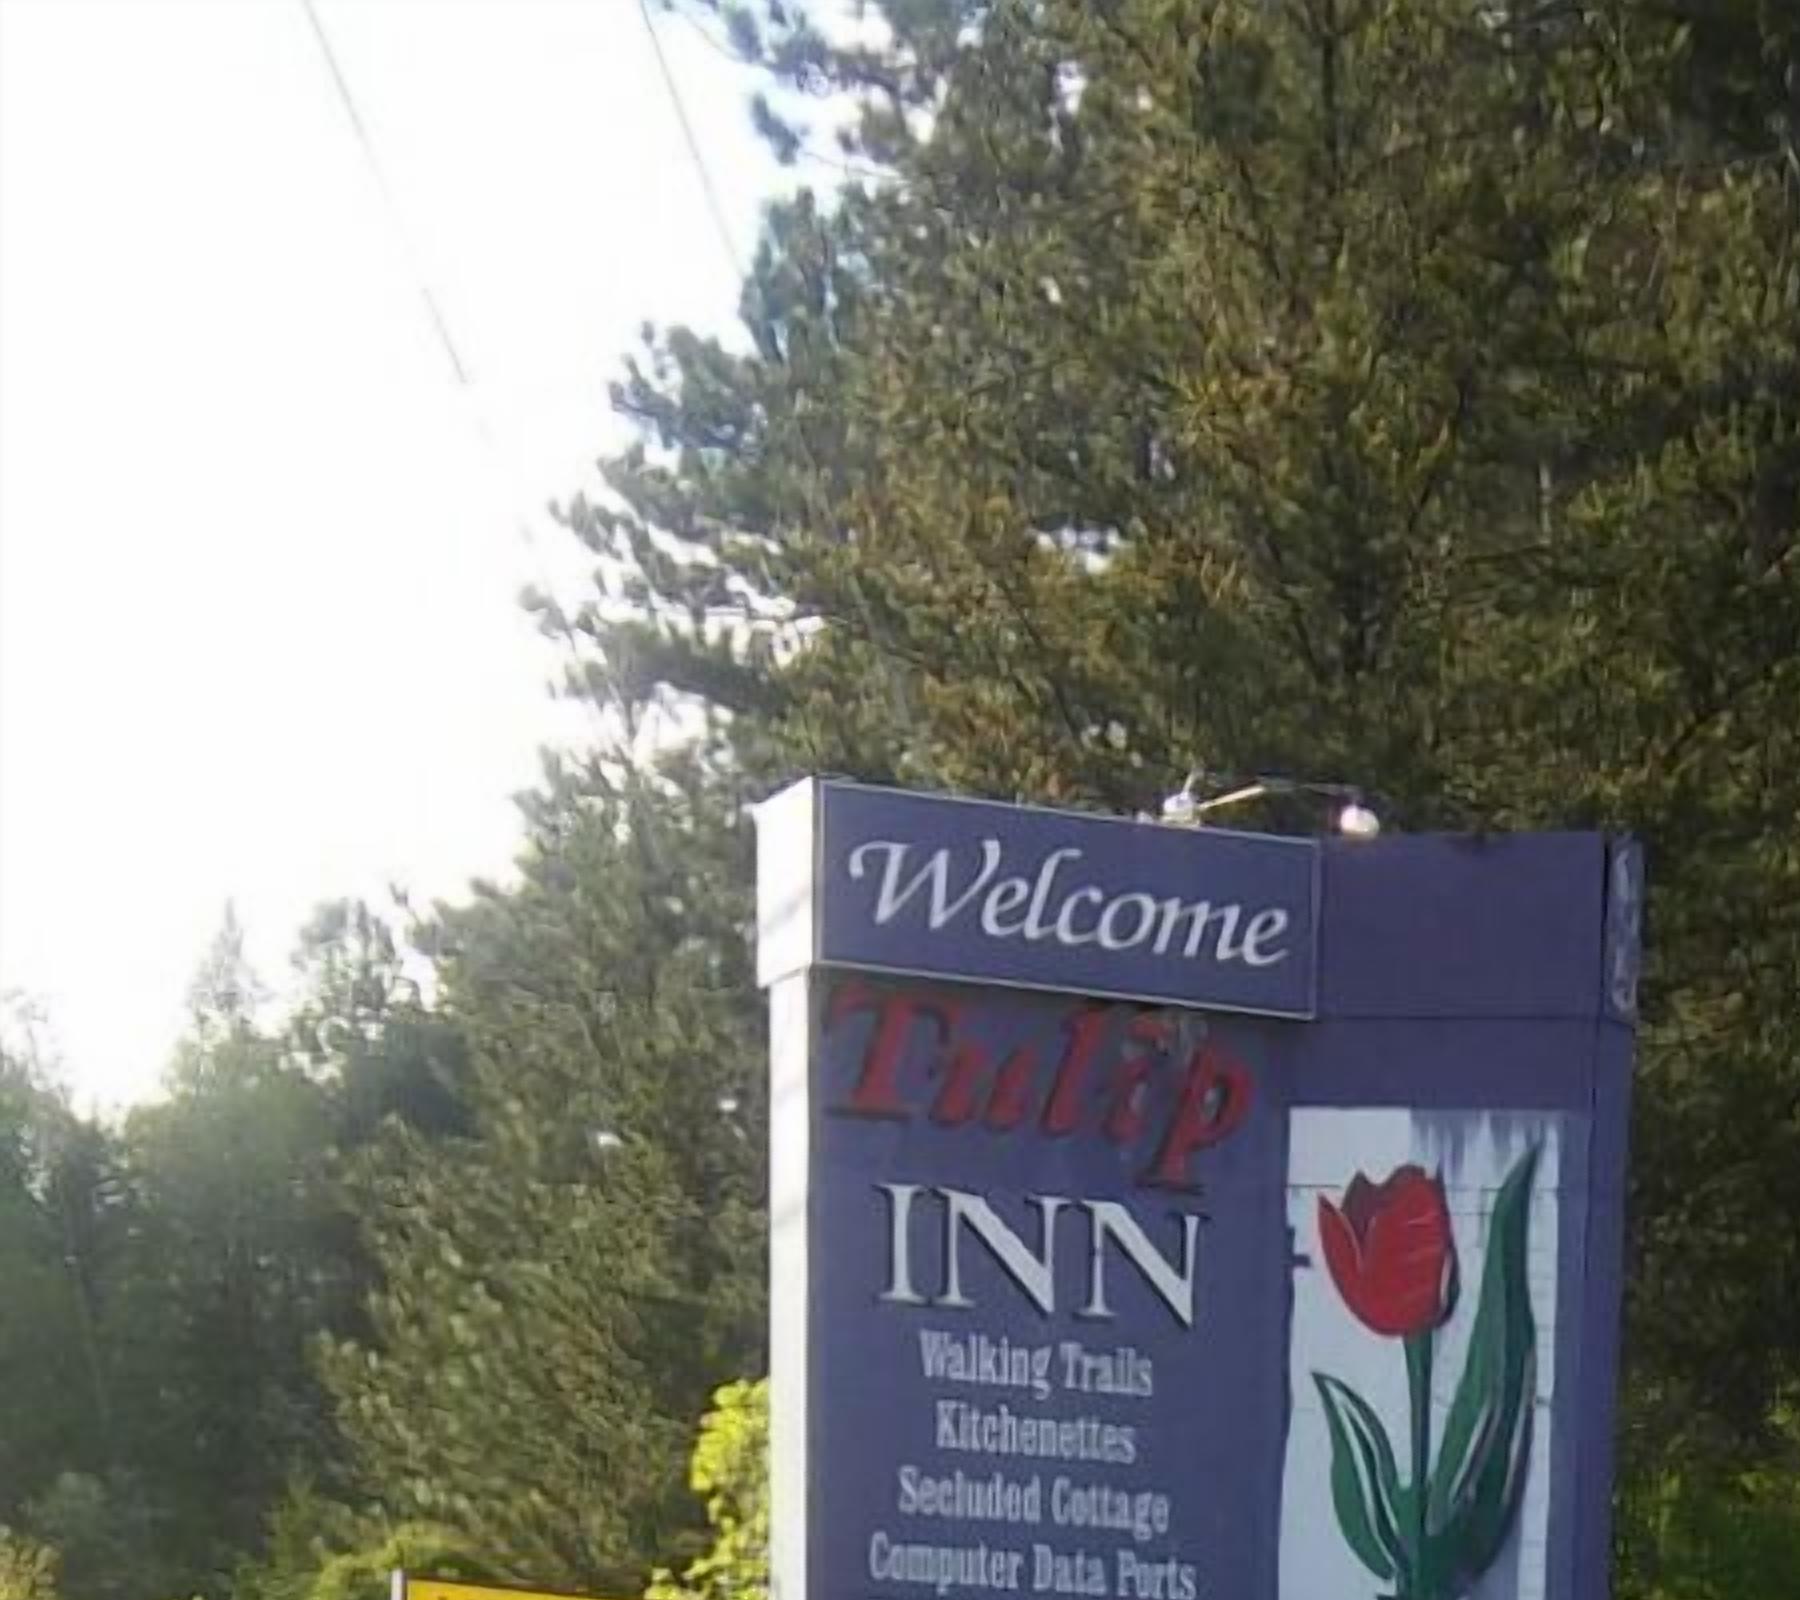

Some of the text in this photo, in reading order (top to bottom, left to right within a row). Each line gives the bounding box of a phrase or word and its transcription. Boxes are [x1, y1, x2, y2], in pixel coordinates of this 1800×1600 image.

[848, 837, 1290, 966] Welcome
[824, 982, 1257, 1194] Tulip
[879, 1182, 1202, 1327] INN
[919, 1329, 1153, 1399] Walking Trails
[935, 1399, 1136, 1464] Kitchenettes
[898, 1465, 1169, 1540] Secluded Cottage
[869, 1531, 1197, 1600] Computer Data Ports
